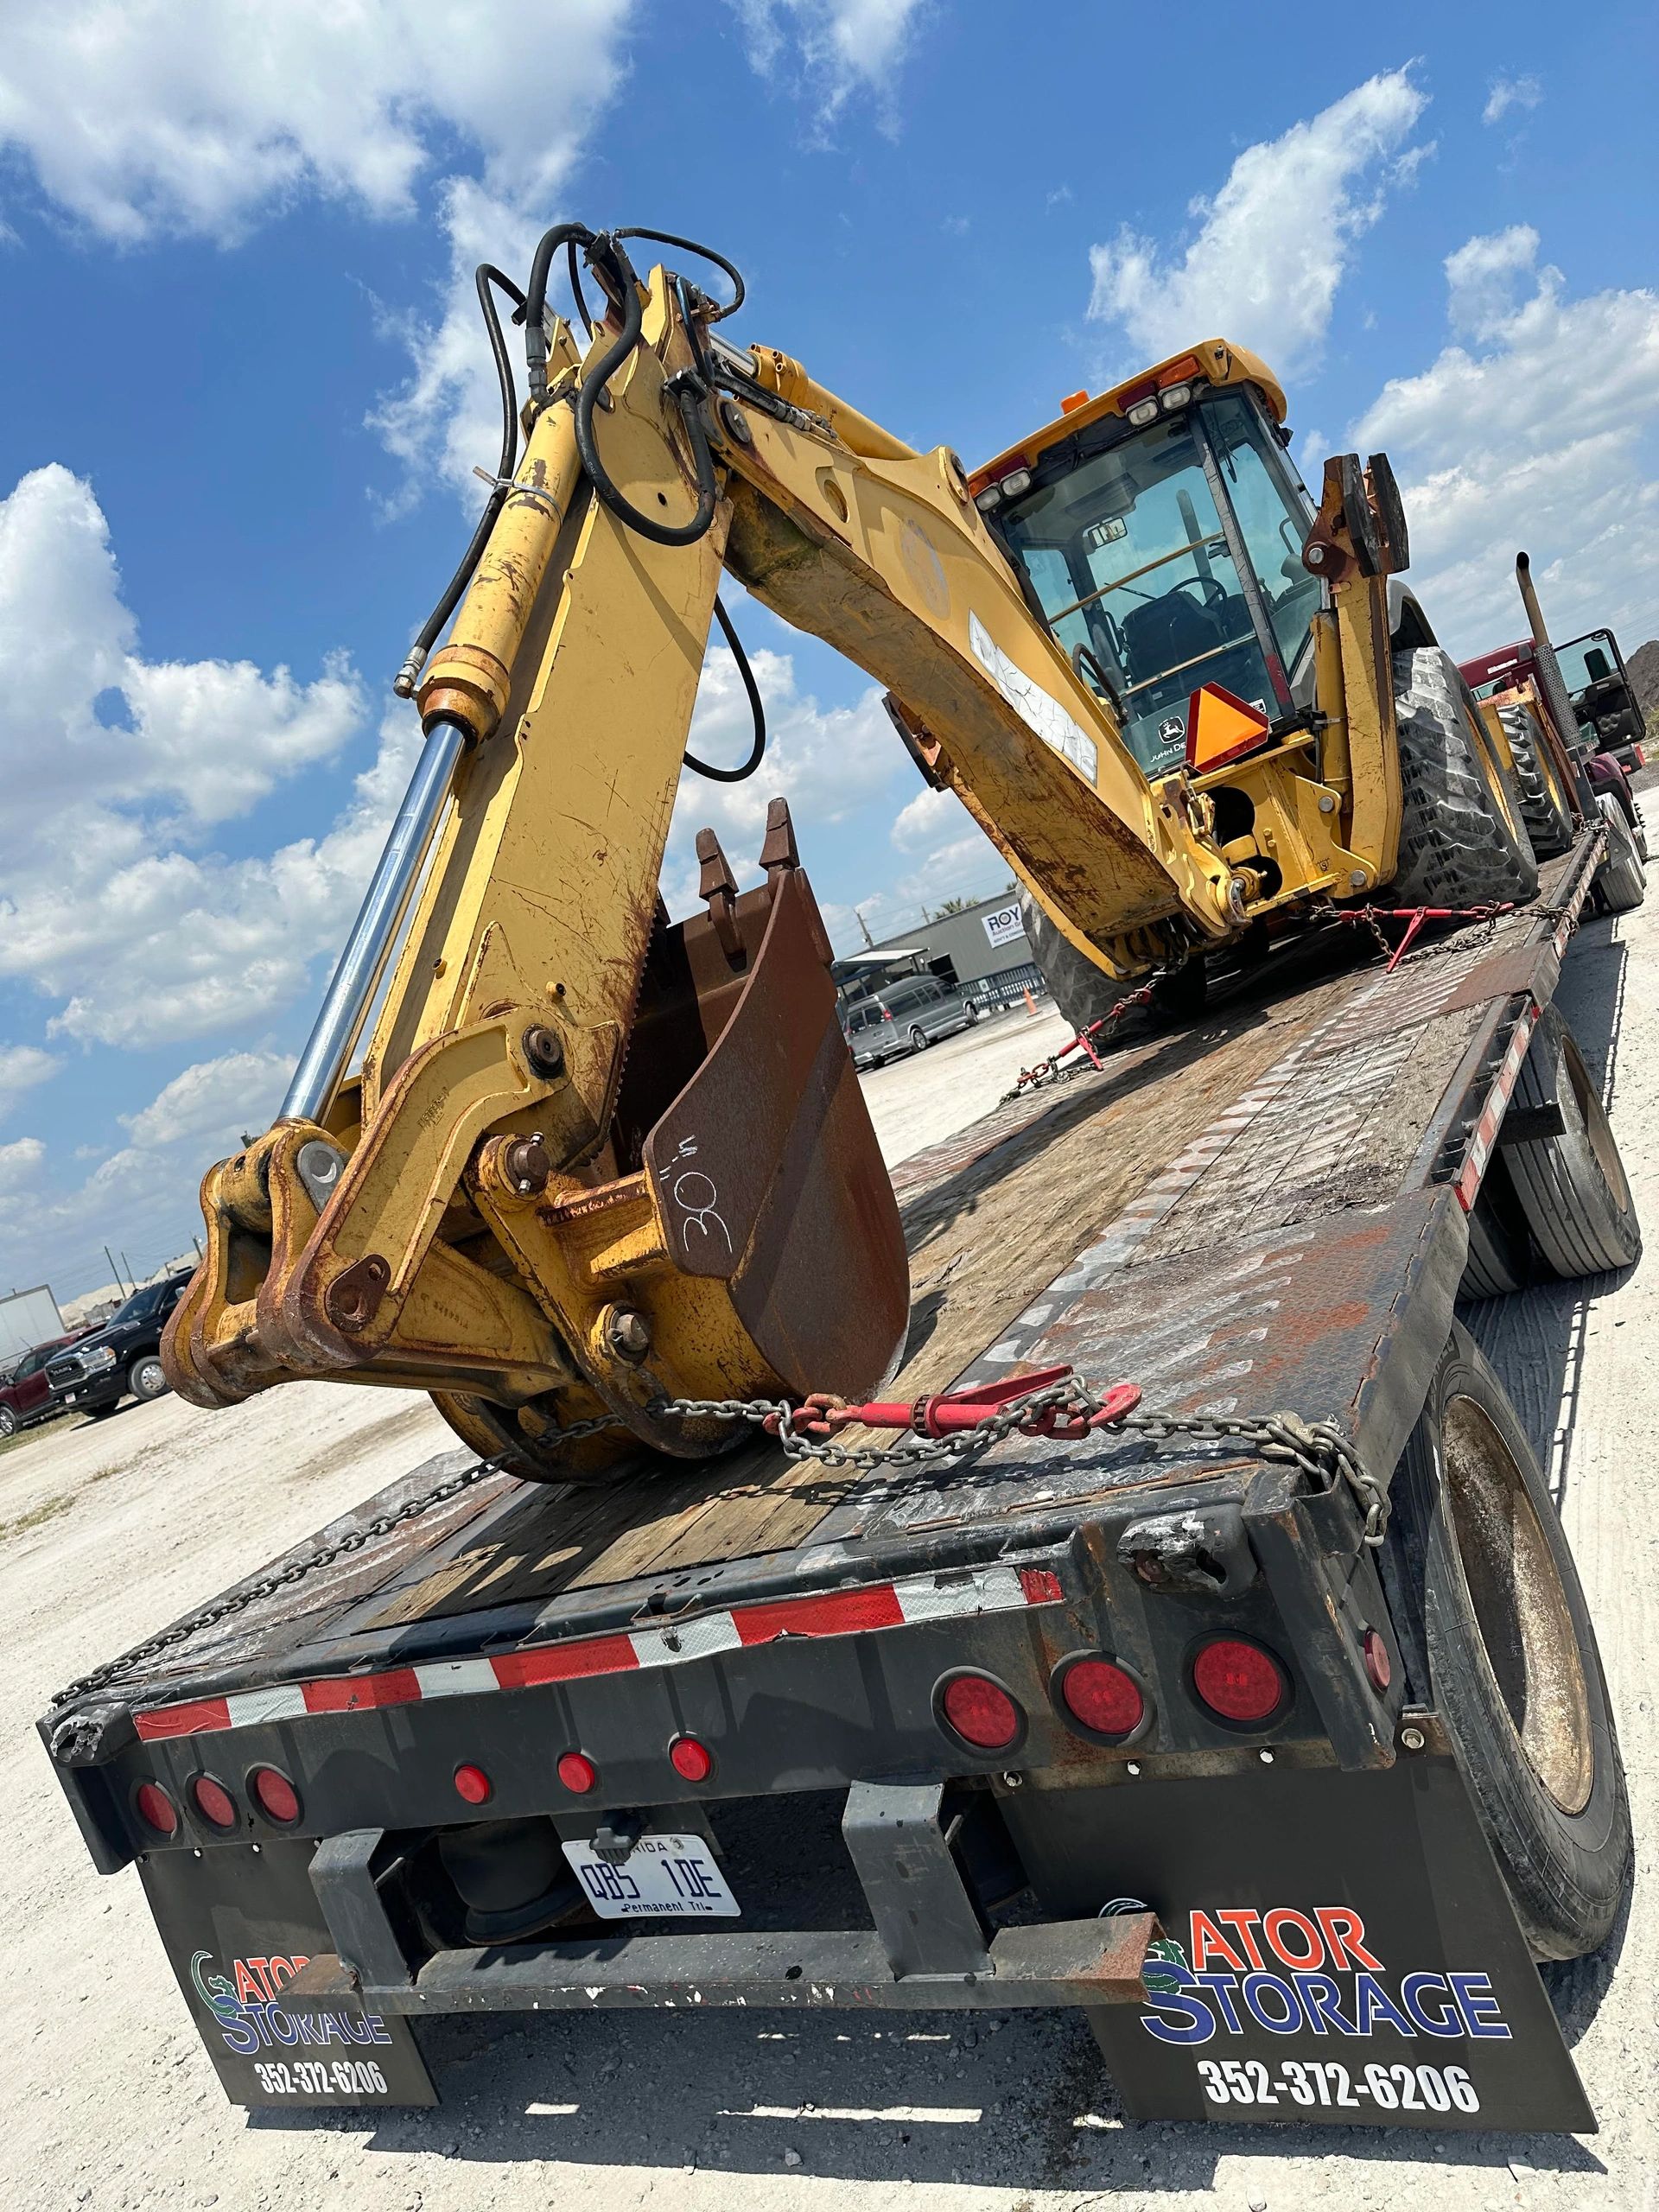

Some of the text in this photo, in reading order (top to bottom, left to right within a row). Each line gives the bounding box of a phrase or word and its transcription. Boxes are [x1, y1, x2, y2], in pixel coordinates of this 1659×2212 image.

[1150, 742, 1185, 762] JOHN DE
[987, 906, 1019, 931] ROY
[631, 1841, 667, 1854] RIDA
[661, 1859, 722, 1898] 1DE
[624, 1901, 683, 1913] Permanent
[1189, 1906, 1386, 1973] ATOR
[1140, 1959, 1514, 2045] STORAGE
[213, 1994, 393, 2055] STORAGE
[254, 2061, 388, 2094] 352-372-6206
[1197, 2060, 1480, 2113] 352-372-6206
